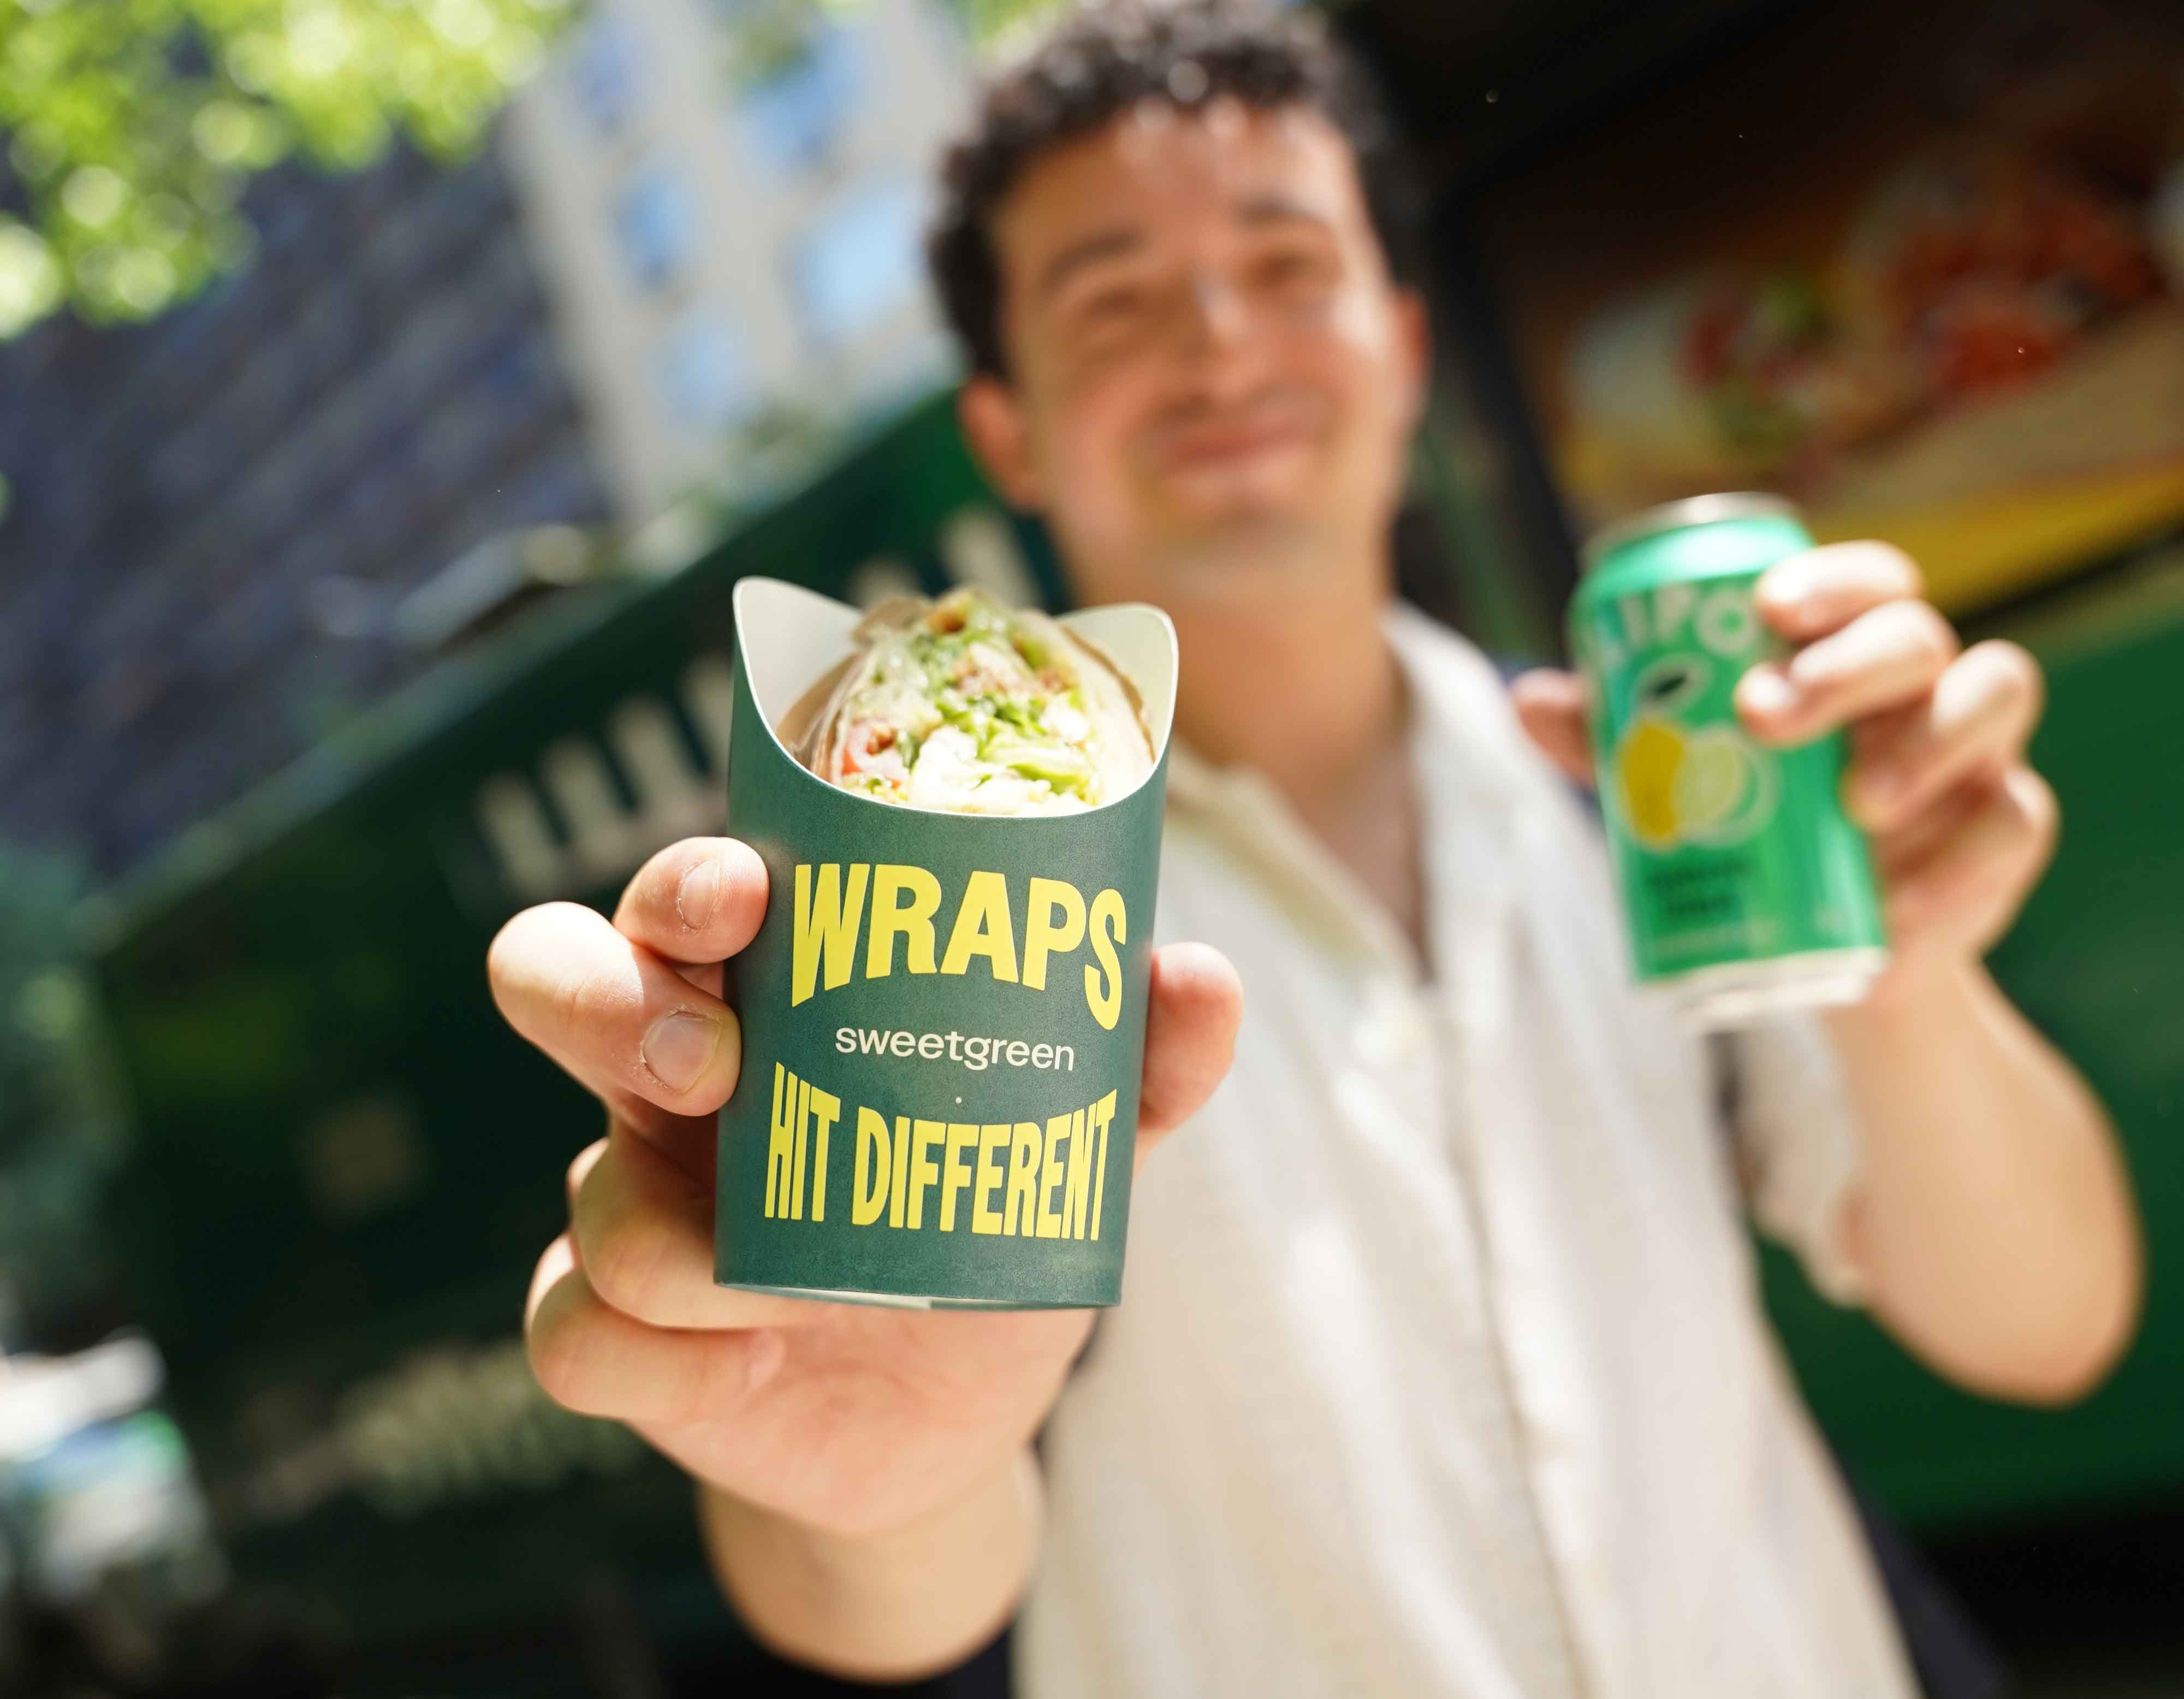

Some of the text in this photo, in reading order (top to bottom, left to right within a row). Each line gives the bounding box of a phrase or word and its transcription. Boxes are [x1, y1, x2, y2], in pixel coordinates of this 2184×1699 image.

[792, 863, 1126, 1031] WRAPS
[835, 1027, 1075, 1071] sweetgreen
[764, 1062, 1117, 1241] HIT DIFFERENT
